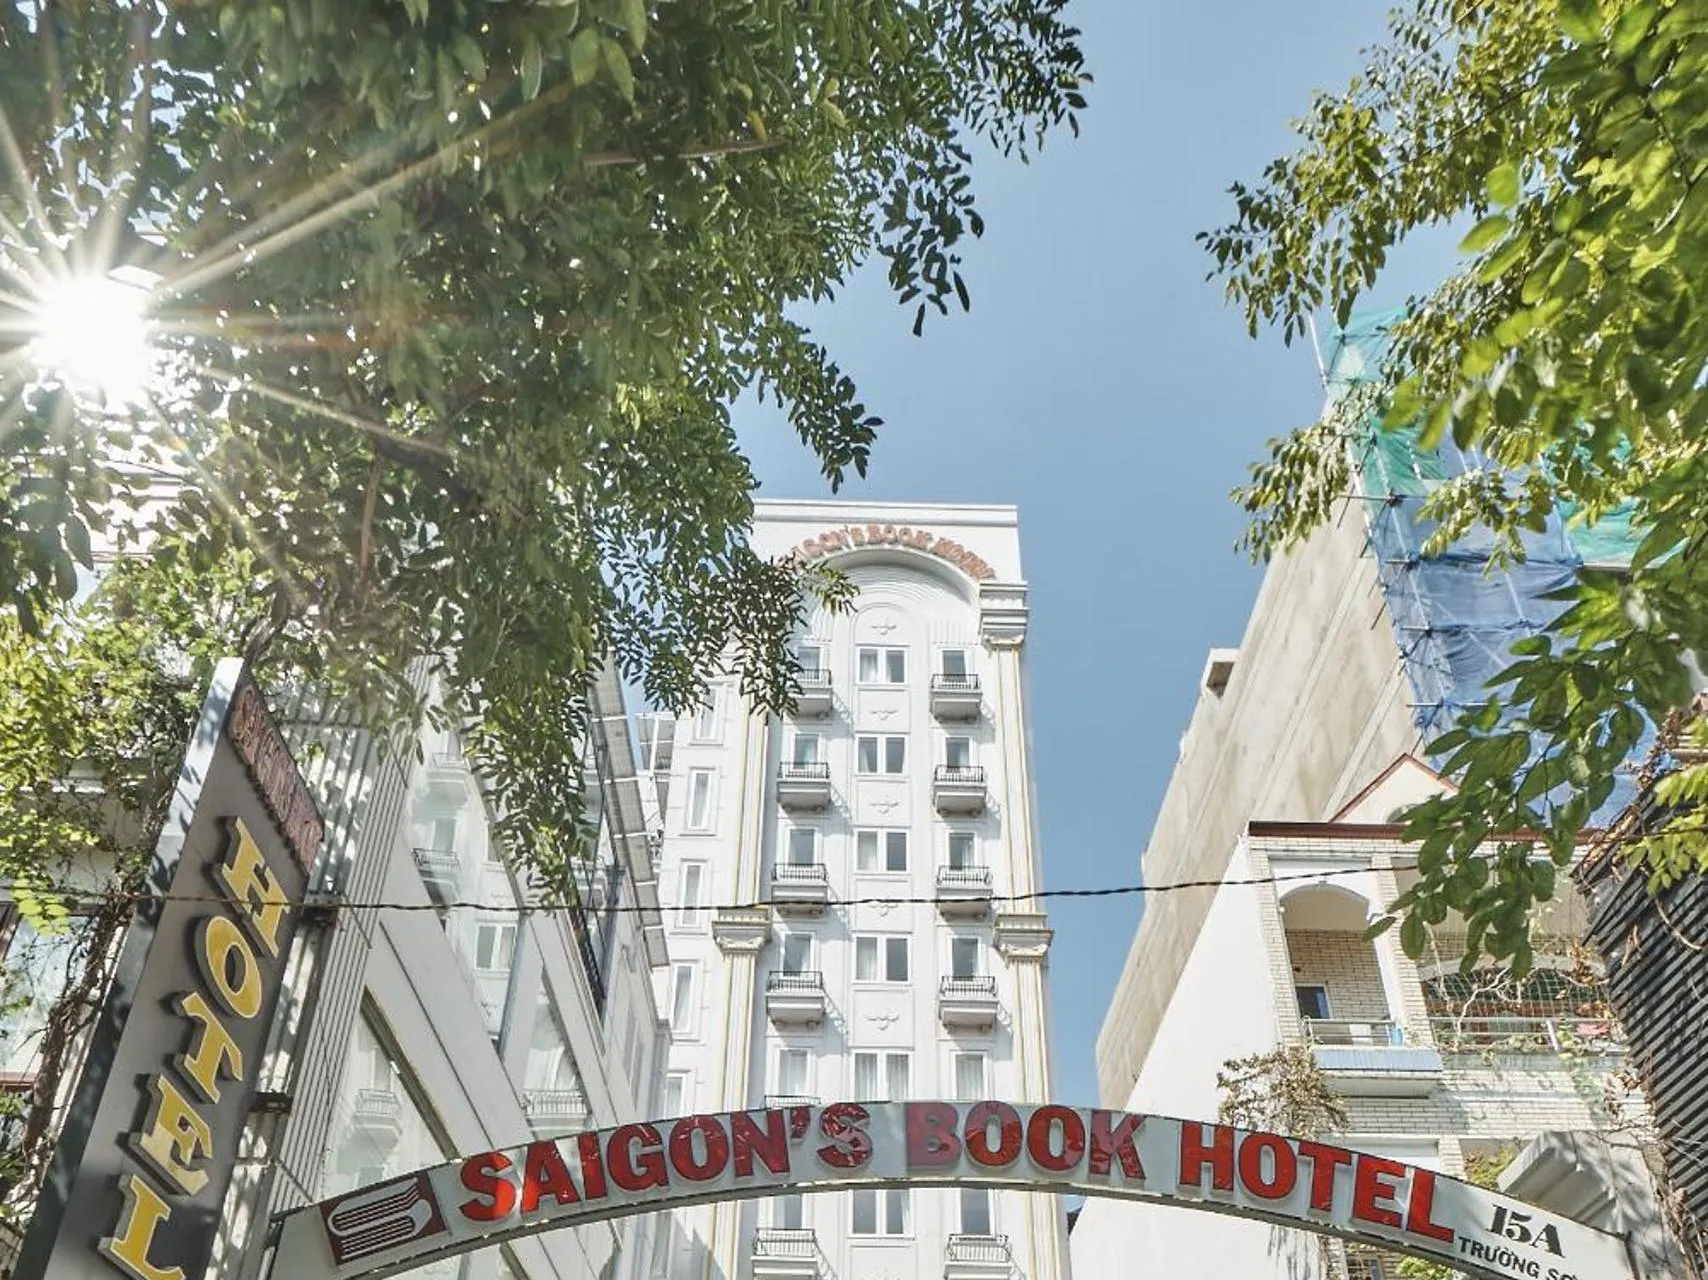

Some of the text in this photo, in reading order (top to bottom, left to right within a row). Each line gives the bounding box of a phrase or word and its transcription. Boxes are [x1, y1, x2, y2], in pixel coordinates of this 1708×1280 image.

[865, 523, 933, 550] BOOK
[458, 1101, 1456, 1245] SAIGON'S BOOK HOTEL
[1485, 1203, 1567, 1259] 15A
